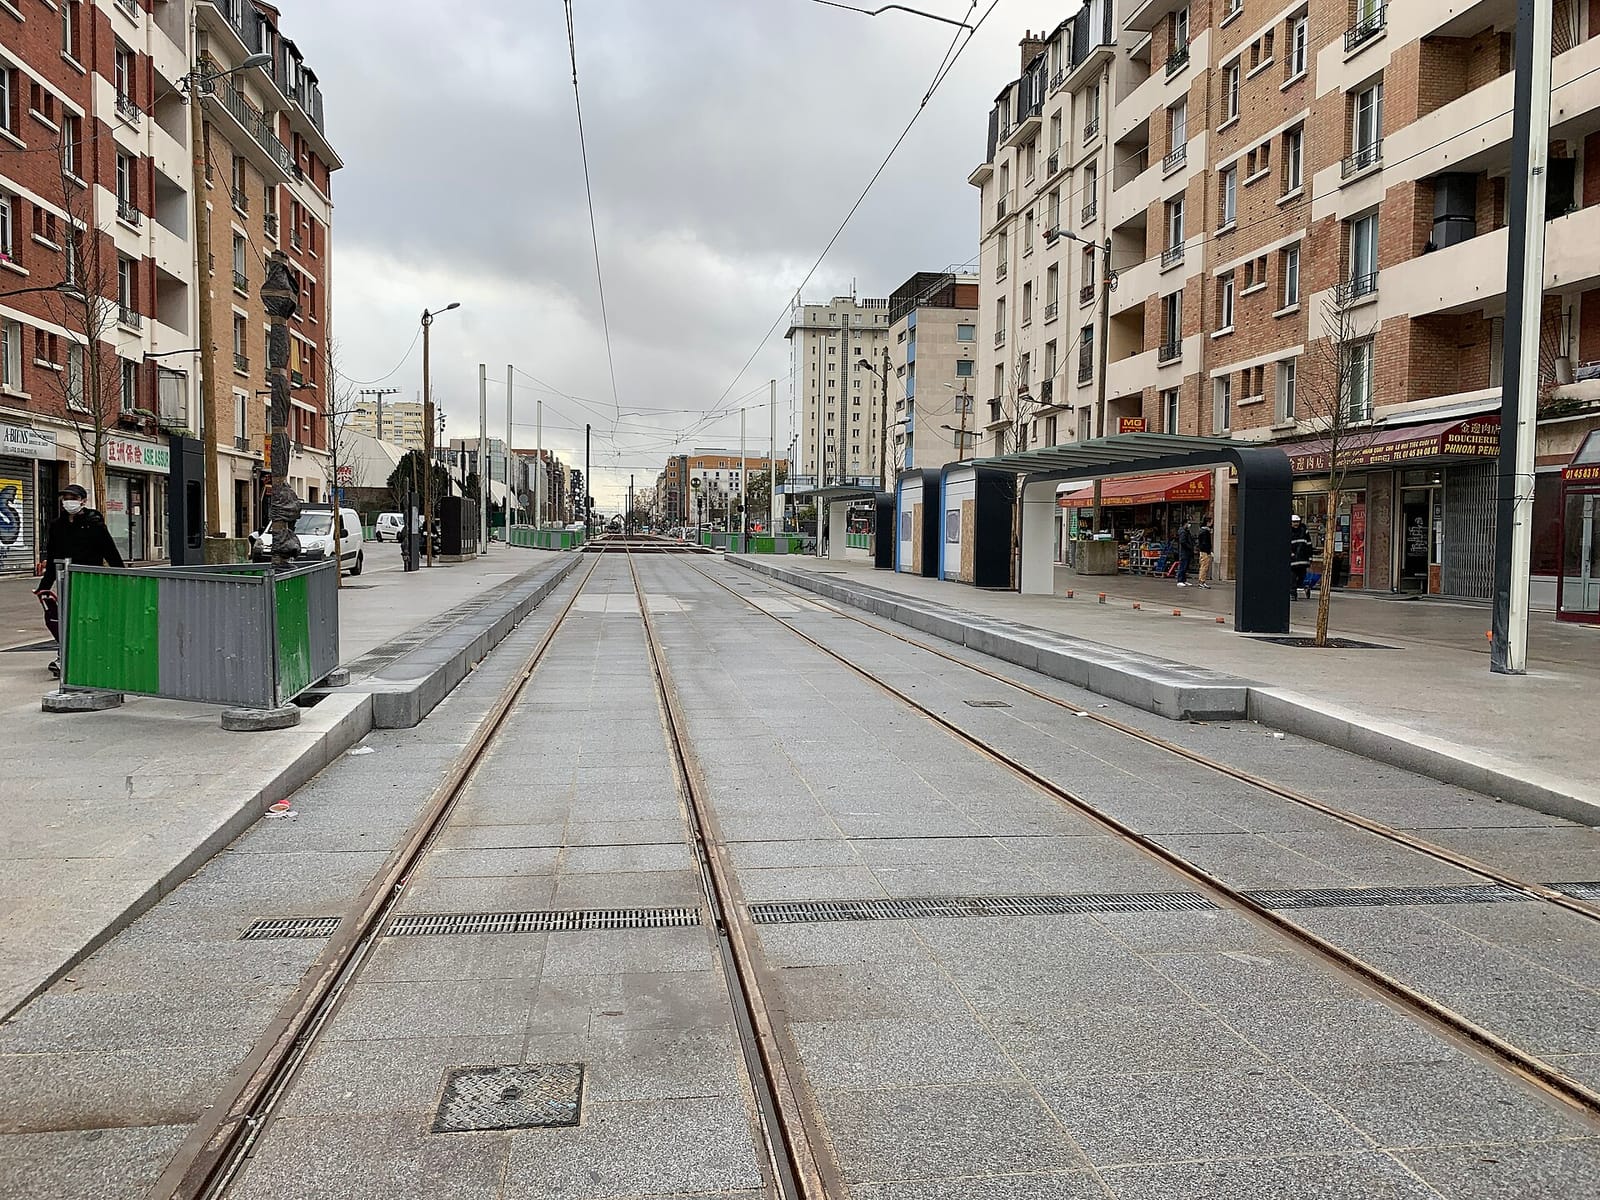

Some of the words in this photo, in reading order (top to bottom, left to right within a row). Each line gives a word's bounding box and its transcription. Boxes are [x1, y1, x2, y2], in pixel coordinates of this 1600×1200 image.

[1448, 434, 1499, 445] BOUCHERIE
[1444, 443, 1476, 455] PHNOM
[1477, 445, 1501, 456] PENH
[1565, 469, 1574, 479] 01
[1574, 468, 1583, 479] 45
